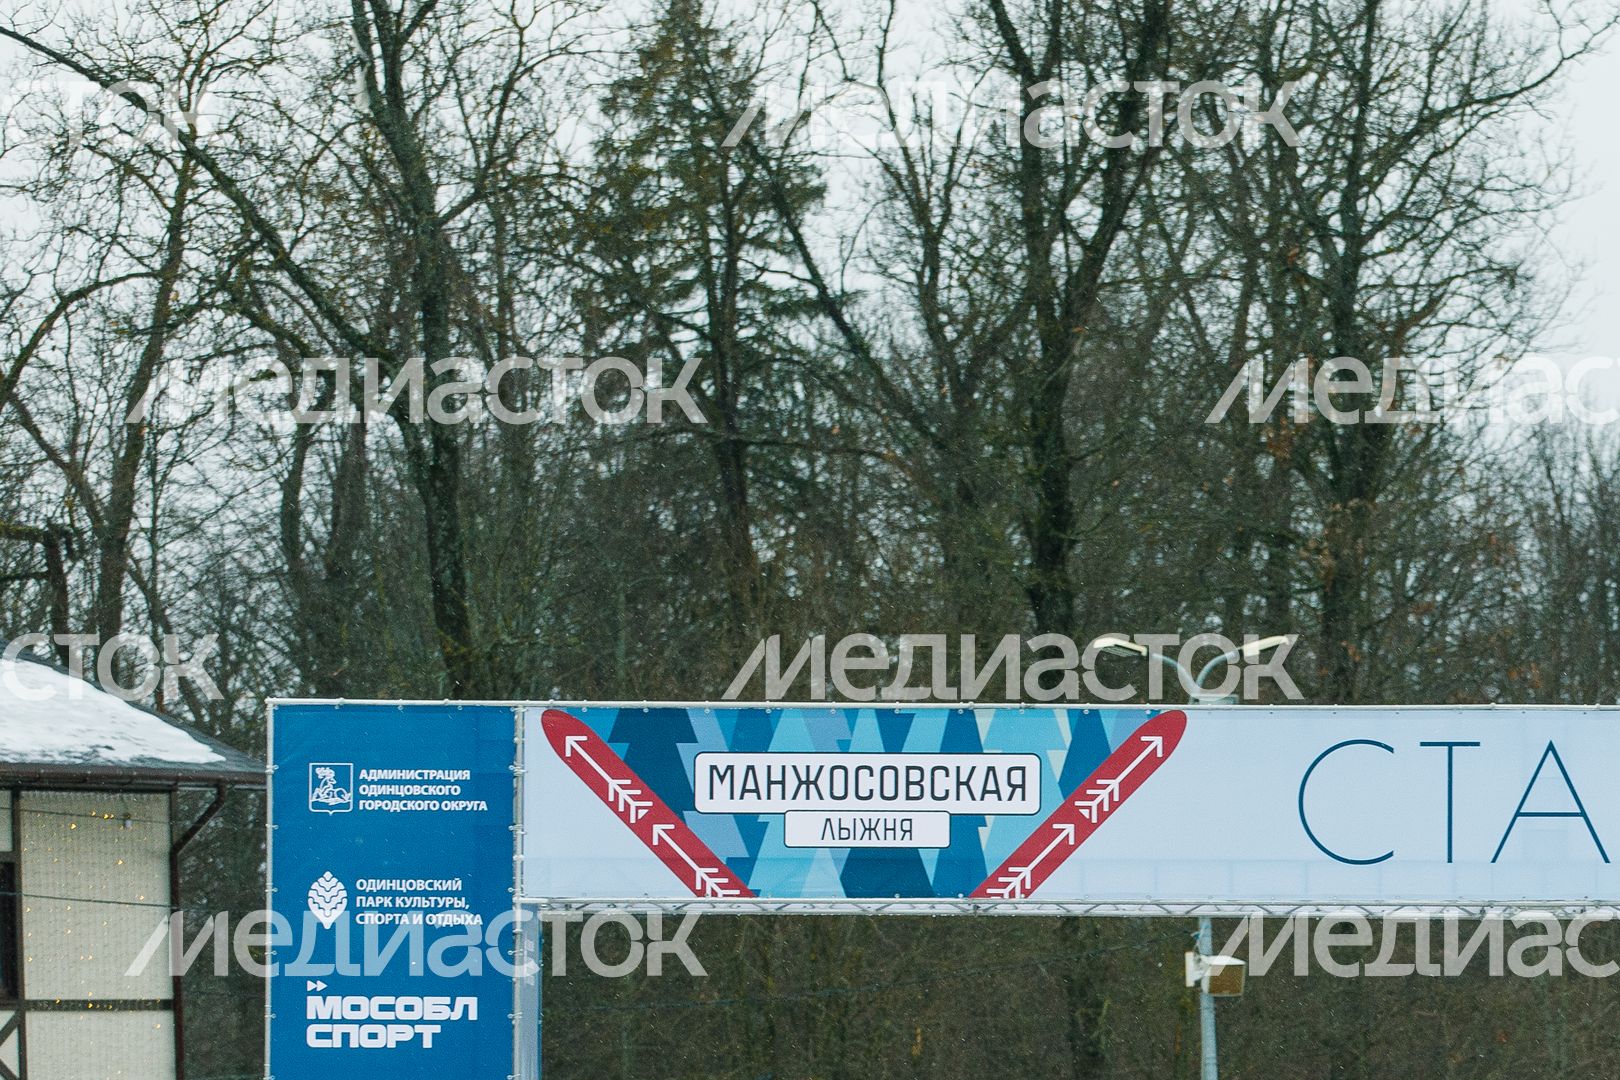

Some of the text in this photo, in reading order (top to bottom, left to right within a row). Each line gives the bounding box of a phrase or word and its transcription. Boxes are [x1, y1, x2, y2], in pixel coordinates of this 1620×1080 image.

[359, 769, 471, 782] АДМИНИСТРАЦИЯ
[707, 763, 1028, 803] МАНЖОСОВСКАЯ
[358, 785, 461, 797] ОДИНЦОВСКОГО
[358, 800, 488, 813] ГОРОДСКОГО ОКРУГА
[820, 818, 914, 842] ЛЫЖНЯ
[356, 878, 463, 892] ОДИНЦОВСКИЙ
[356, 896, 470, 909] ПАРК КУЛЬТУРЫ,
[356, 913, 483, 927] СПОРТА И ОТДЫХА
[306, 995, 478, 1021] МОСОБЛ
[306, 1024, 441, 1048] СПОРТ
